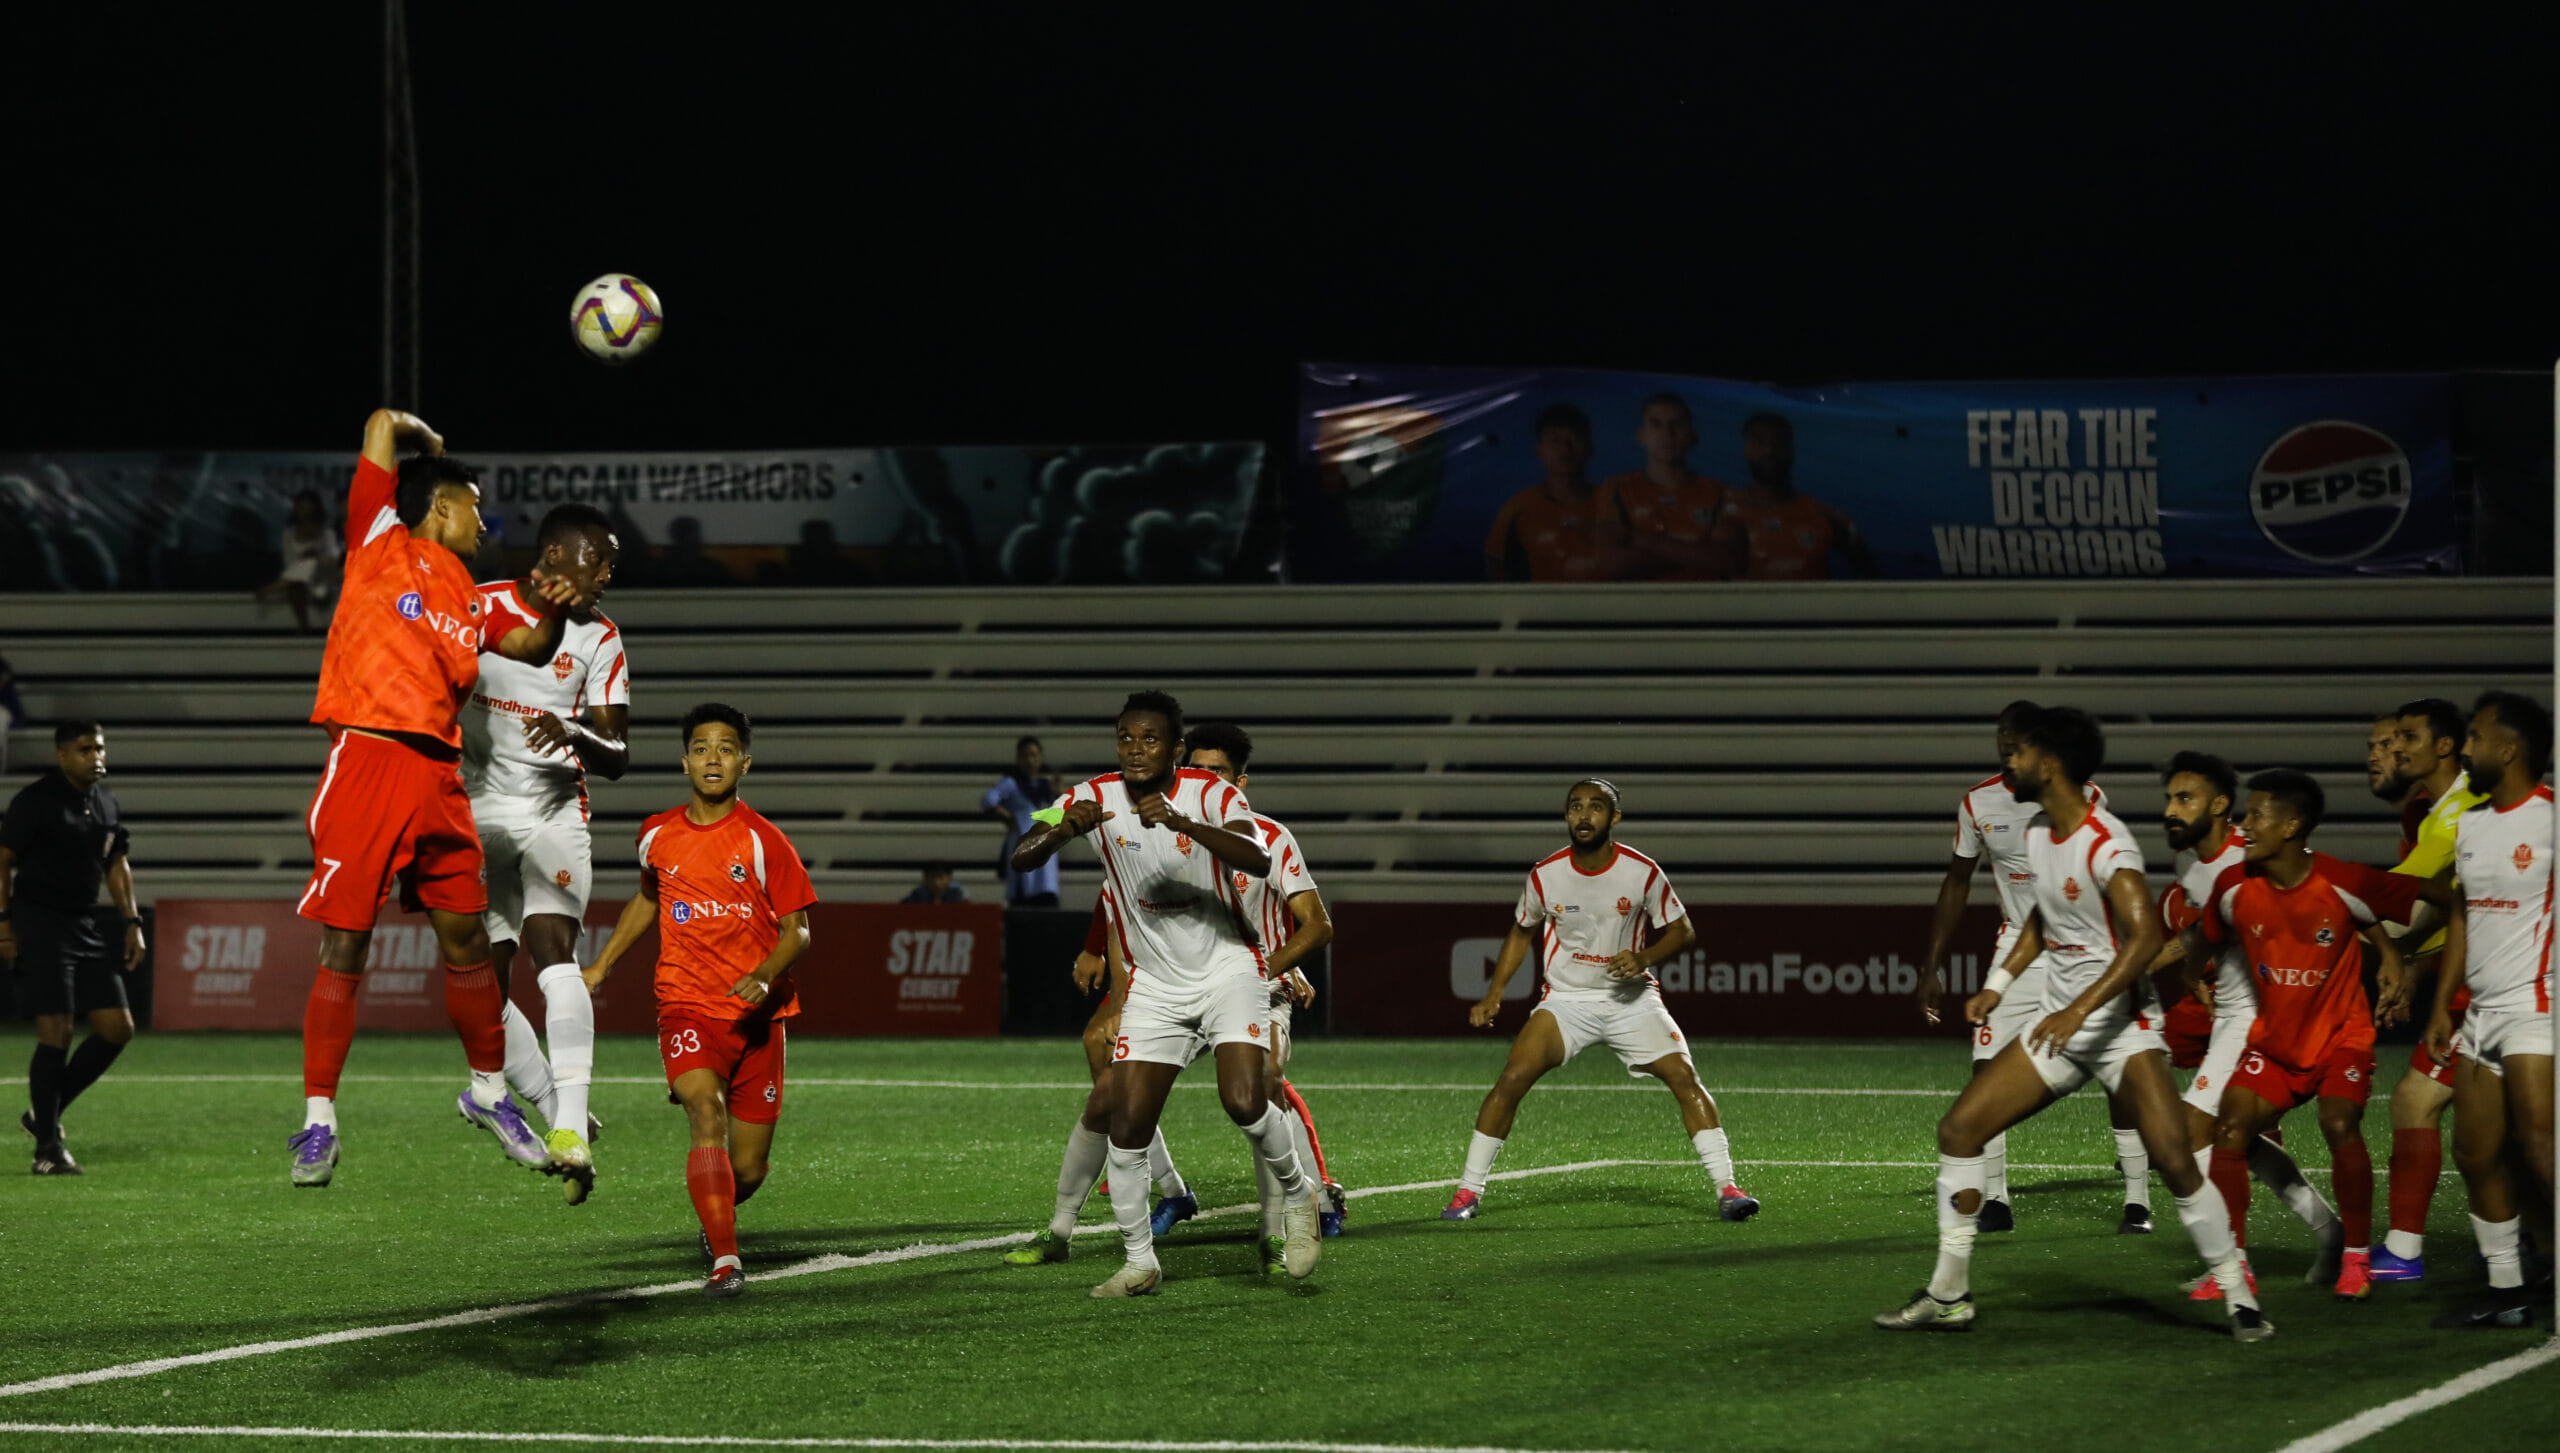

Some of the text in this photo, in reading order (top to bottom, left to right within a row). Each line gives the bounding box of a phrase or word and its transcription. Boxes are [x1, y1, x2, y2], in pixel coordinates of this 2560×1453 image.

[1967, 408, 2156, 468] FEAR THE
[497, 465, 637, 501] DECCAN
[648, 463, 835, 501] WARRIORS
[1989, 470, 2158, 527] DECCAN
[2260, 464, 2401, 510] PEPSI
[1931, 525, 2166, 576] WARRIORS
[424, 608, 479, 653] NEC
[319, 857, 342, 897] 7
[181, 926, 267, 971] STAR
[887, 929, 975, 975] STAR
[899, 978, 961, 1000] CEMENT
[670, 1028, 701, 1059] 33
[1115, 1036, 1129, 1060] 5
[1973, 1025, 1992, 1046] 6
